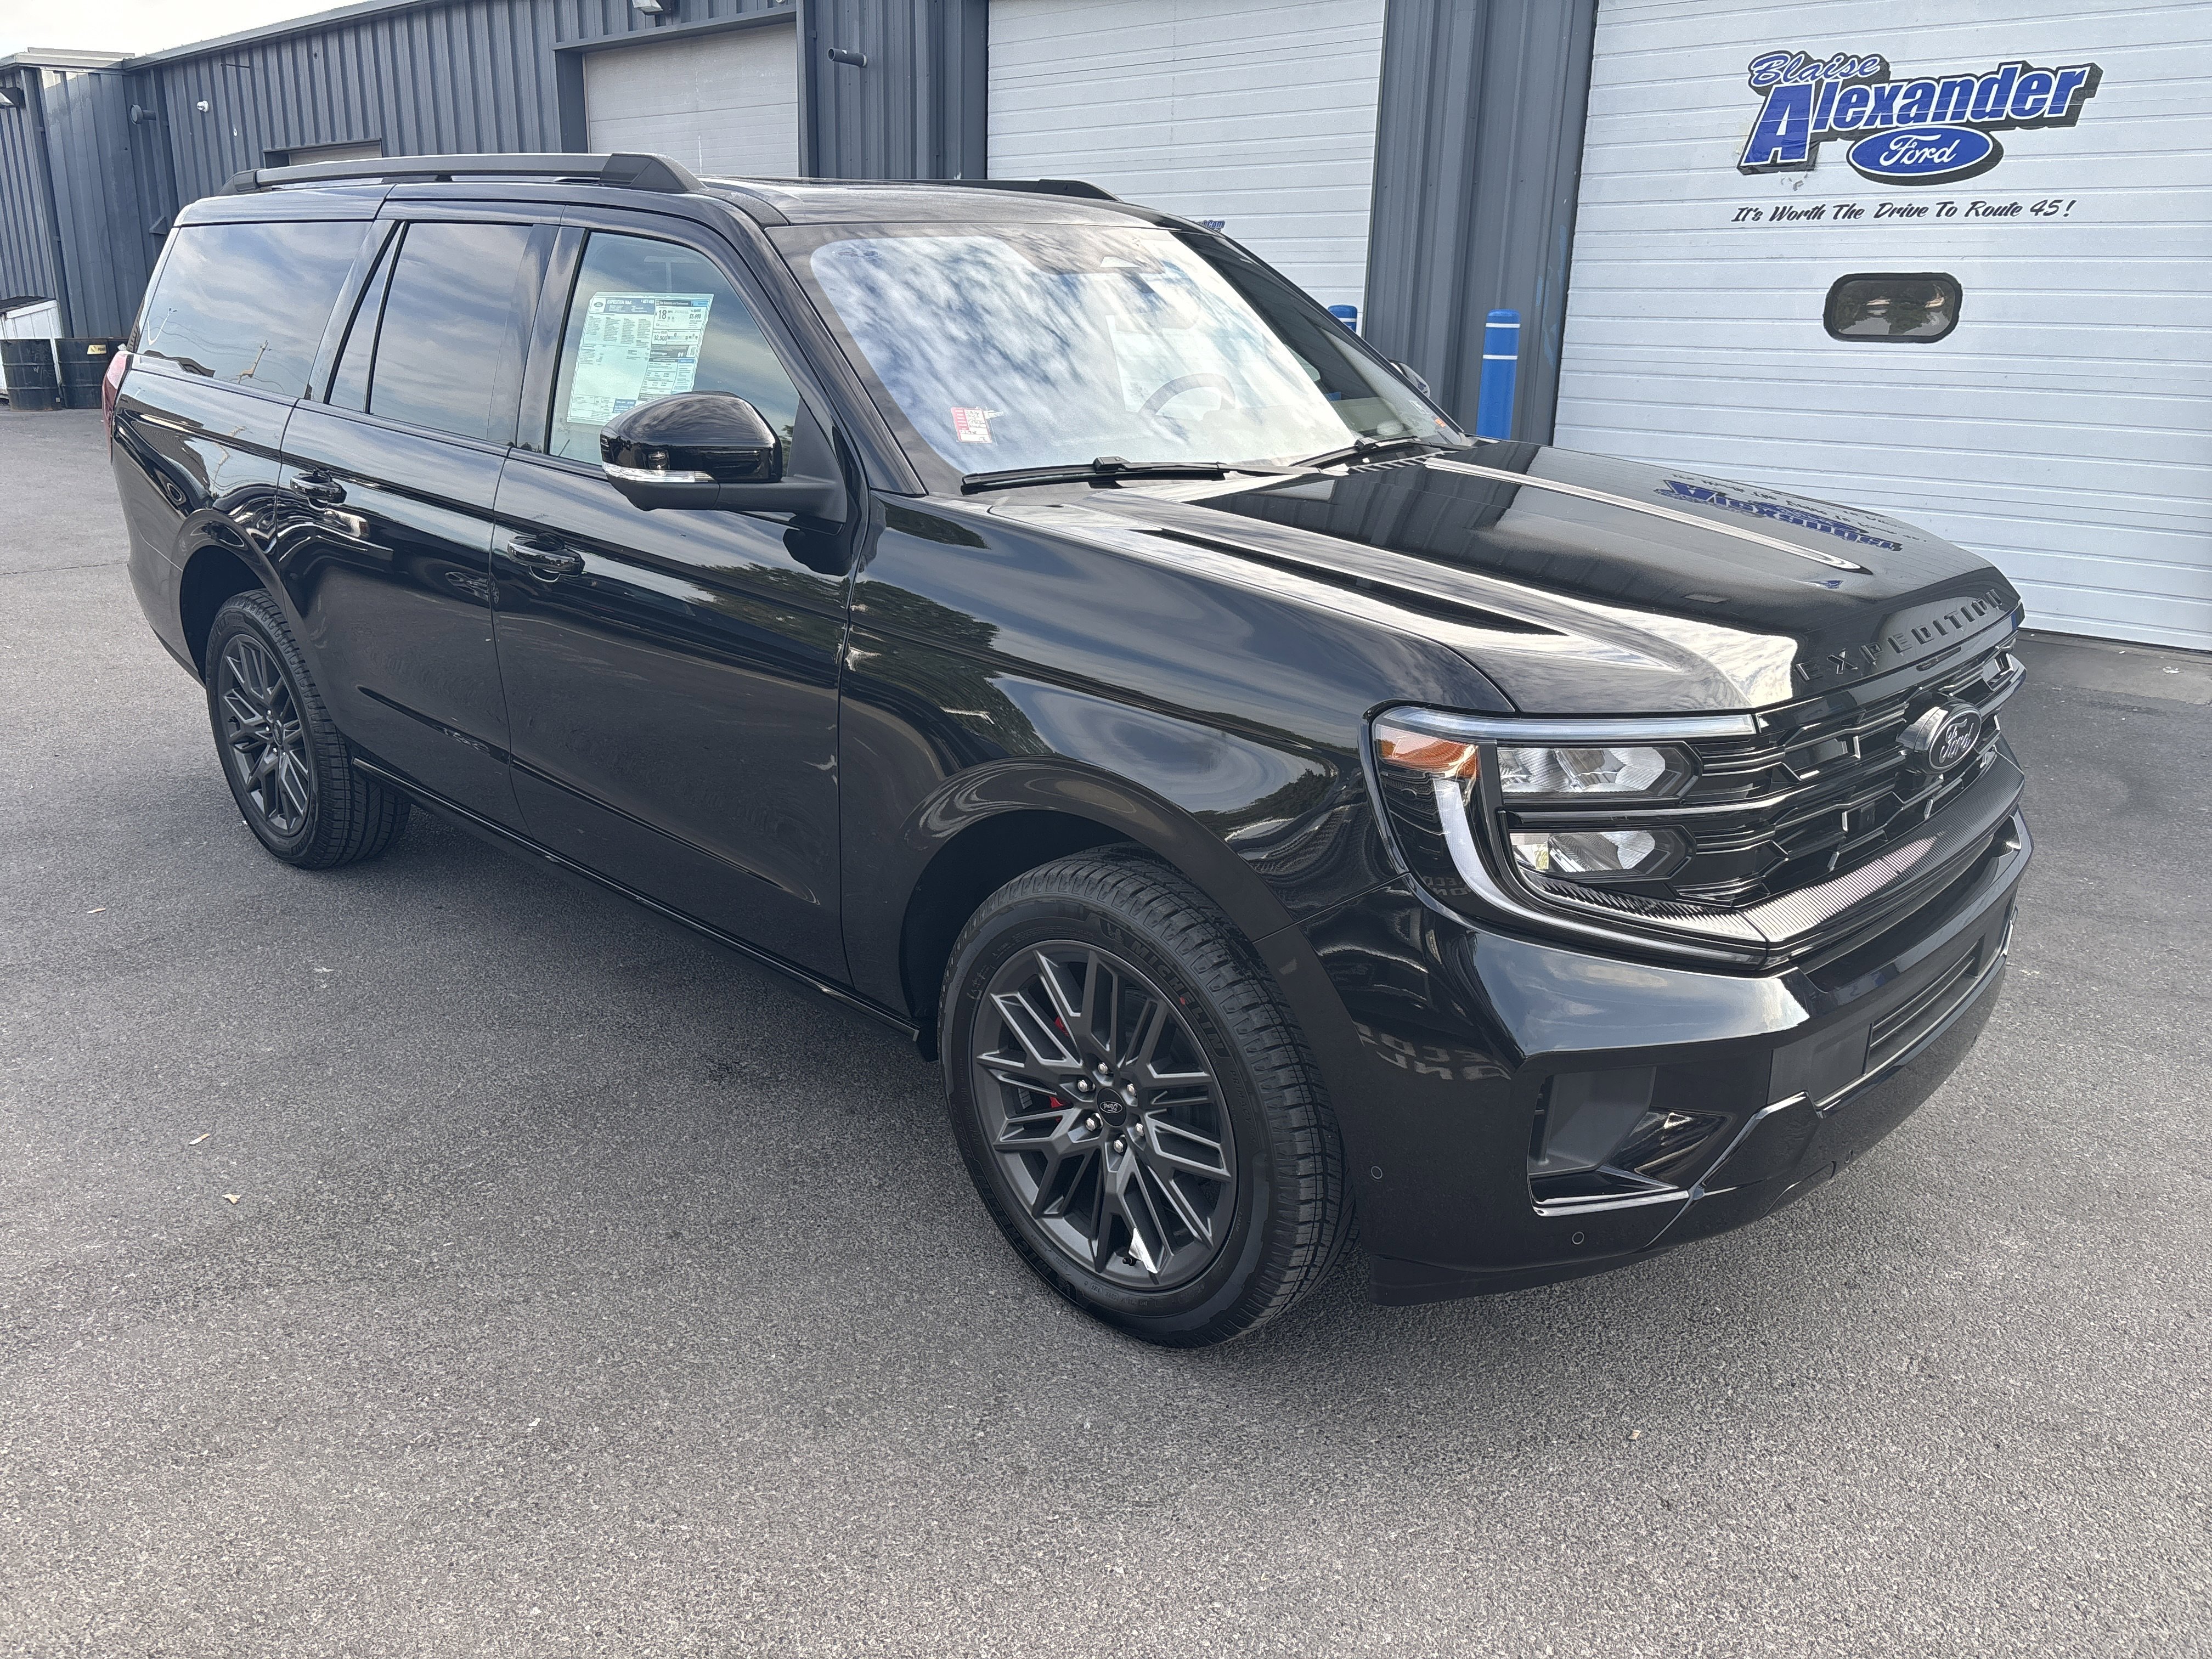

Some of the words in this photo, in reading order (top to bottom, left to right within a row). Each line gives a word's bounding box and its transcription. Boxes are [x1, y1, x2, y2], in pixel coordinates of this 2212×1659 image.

[1750, 52, 1881, 86] Blaise
[1740, 63, 2091, 167] Alexander
[1879, 134, 1961, 166] Ford
[1731, 206, 1763, 222] It's
[1769, 204, 1825, 222] Worth
[1833, 203, 1866, 220] The
[1873, 202, 1929, 218] Drive
[1935, 201, 1958, 217] To
[1964, 200, 2022, 217] Route
[2030, 199, 2077, 218] 45!
[658, 309, 667, 320] 18
[1794, 589, 2003, 681] EXPEDITION
[1938, 719, 1975, 764] Ford
[1130, 940, 1224, 1049] MICHELIN
[1103, 1103, 1118, 1113] Ford
[1229, 1070, 1253, 1125] PRIMACY
[976, 1175, 1052, 1276] MICHELIN
